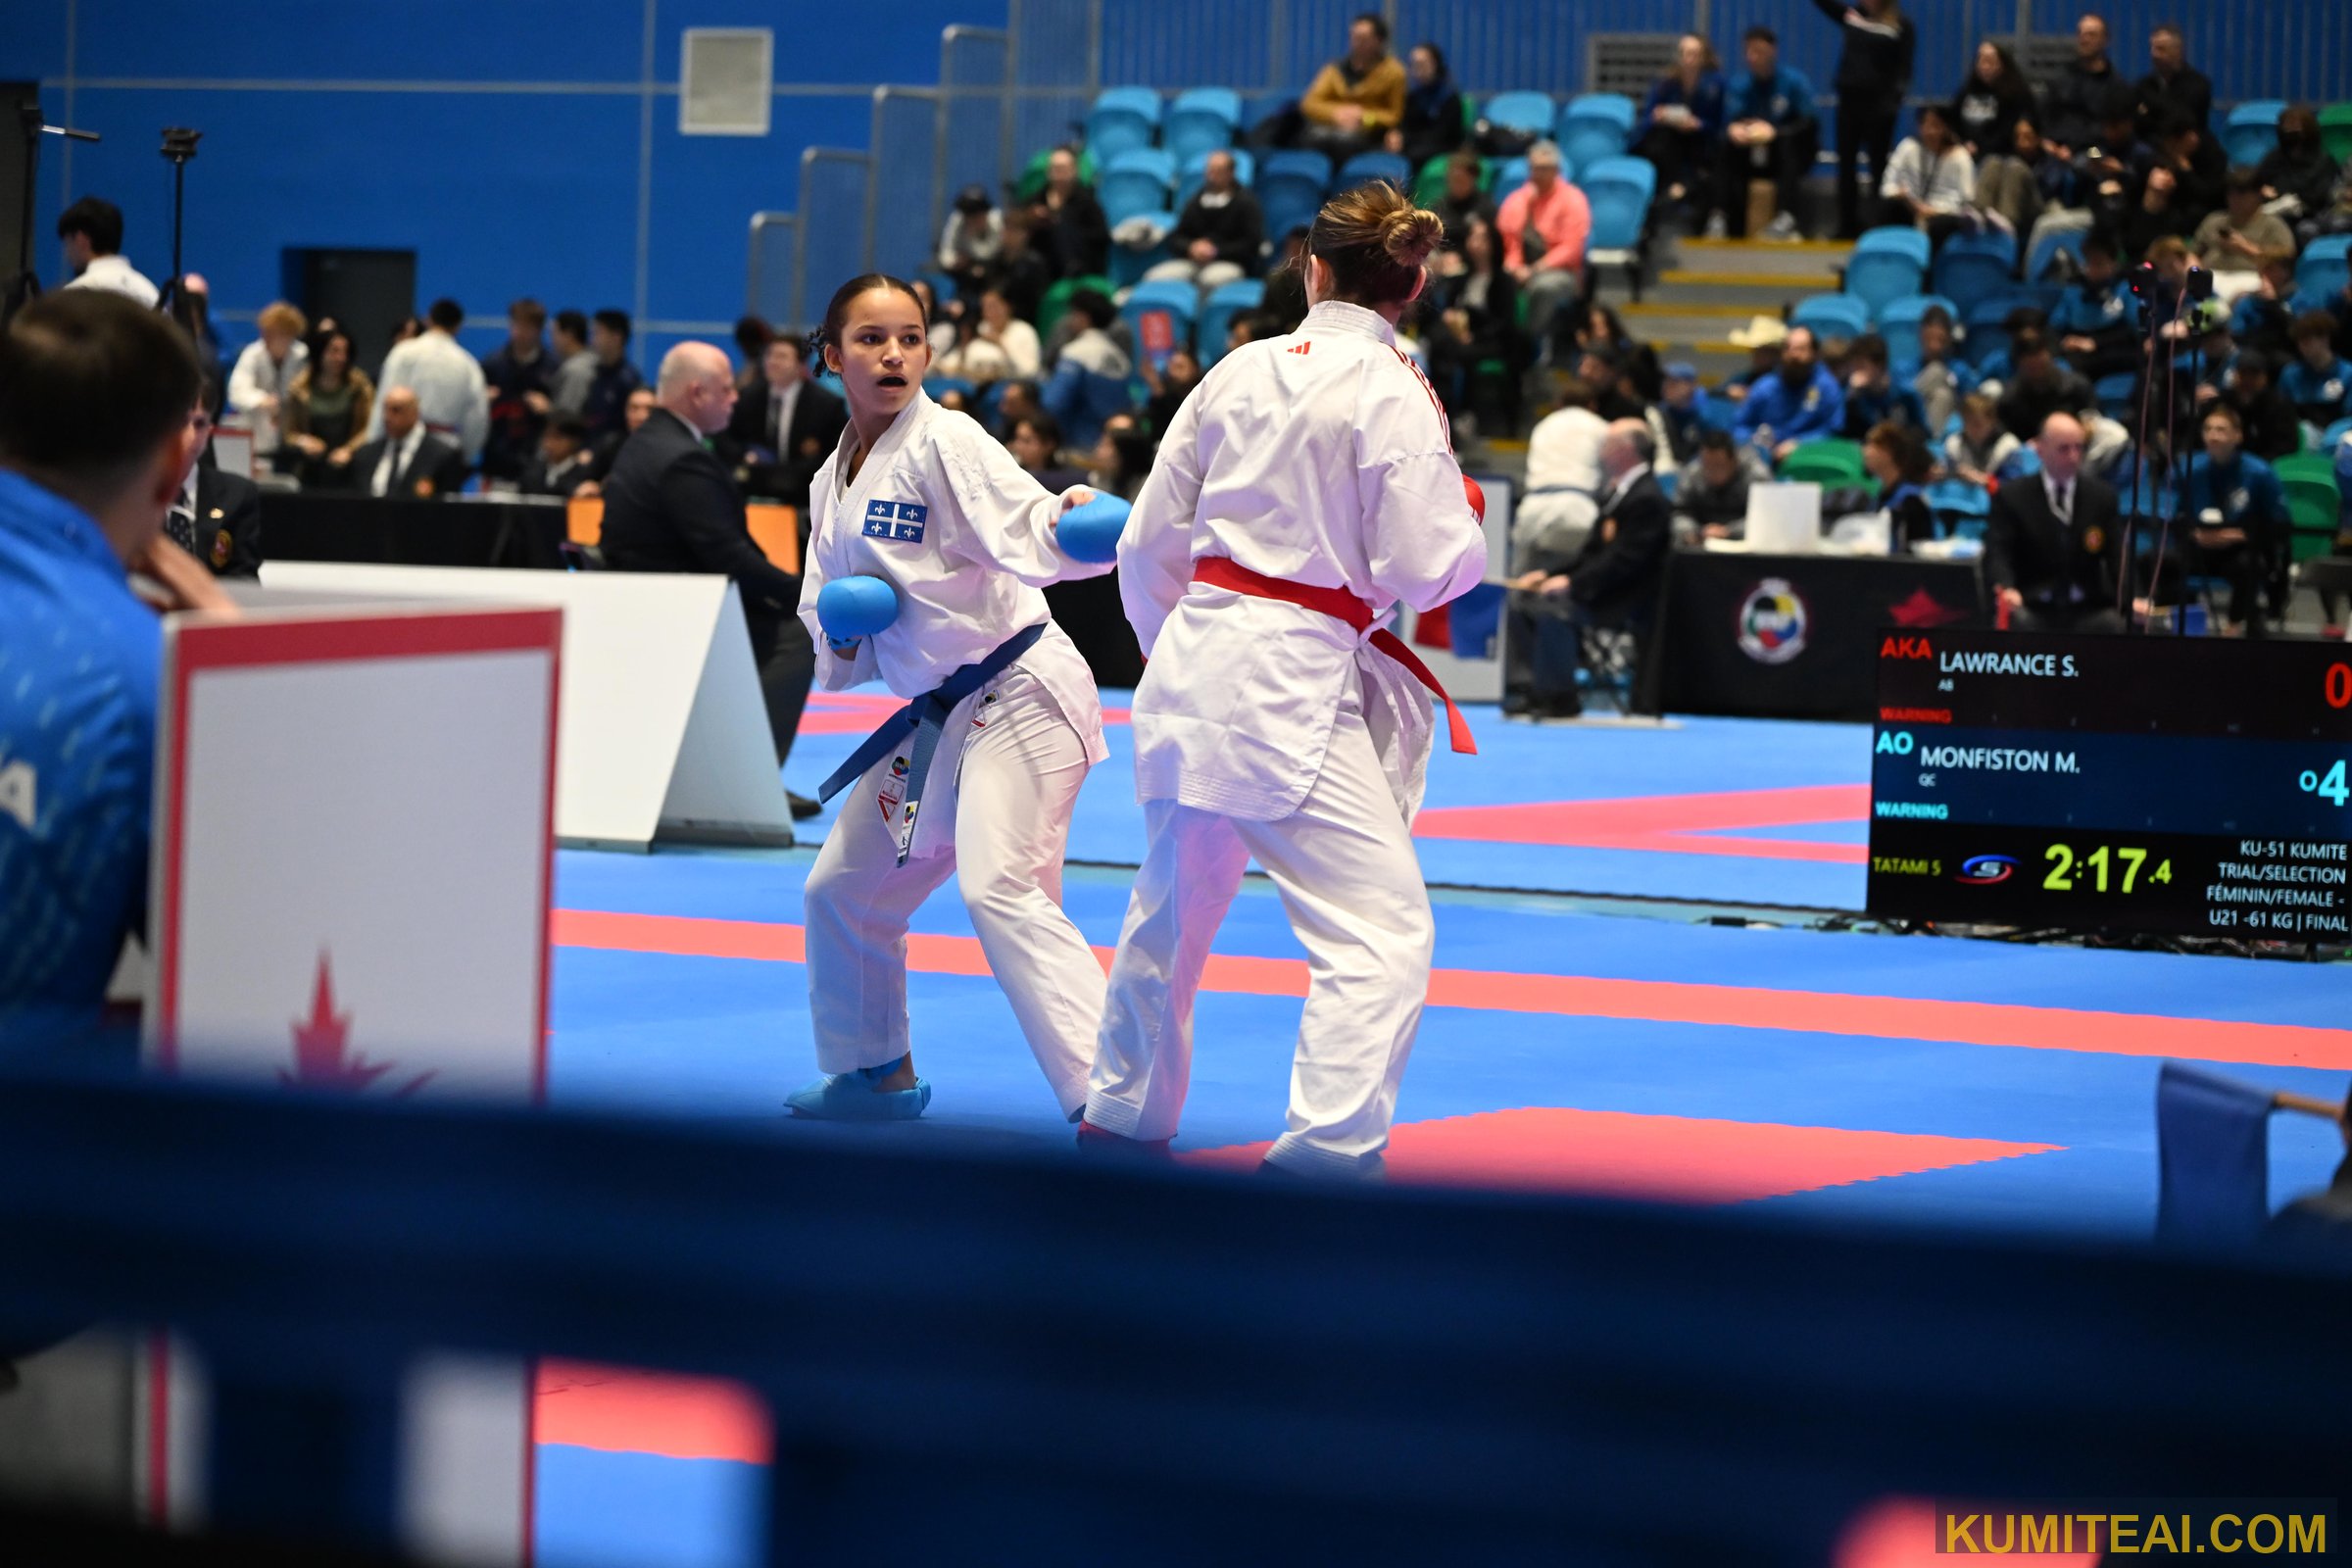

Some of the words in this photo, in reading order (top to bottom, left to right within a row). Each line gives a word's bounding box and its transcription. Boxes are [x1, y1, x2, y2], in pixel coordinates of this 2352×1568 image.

[1881, 637, 1933, 660] AKA
[1939, 651, 2056, 676] LAWRANCE
[2061, 655, 2080, 677] S.
[2326, 662, 2352, 709] 0
[1880, 707, 1952, 724] WARNING
[1876, 731, 1914, 755] AO
[1920, 746, 2049, 771] MONFISTON
[2055, 752, 2081, 773] M.
[1876, 802, 1949, 820] WARNING
[2240, 840, 2284, 858] KU-51
[2290, 843, 2348, 860] KUMITE
[1873, 857, 1929, 874] TATAMI
[2218, 862, 2347, 884] TRIAL/SELECTION
[2206, 883, 2334, 907] FÉMININ/FEMALE
[2209, 909, 2237, 926] U21
[2243, 910, 2267, 928] -61
[2272, 912, 2293, 929] KG
[2305, 914, 2349, 932] FINAL
